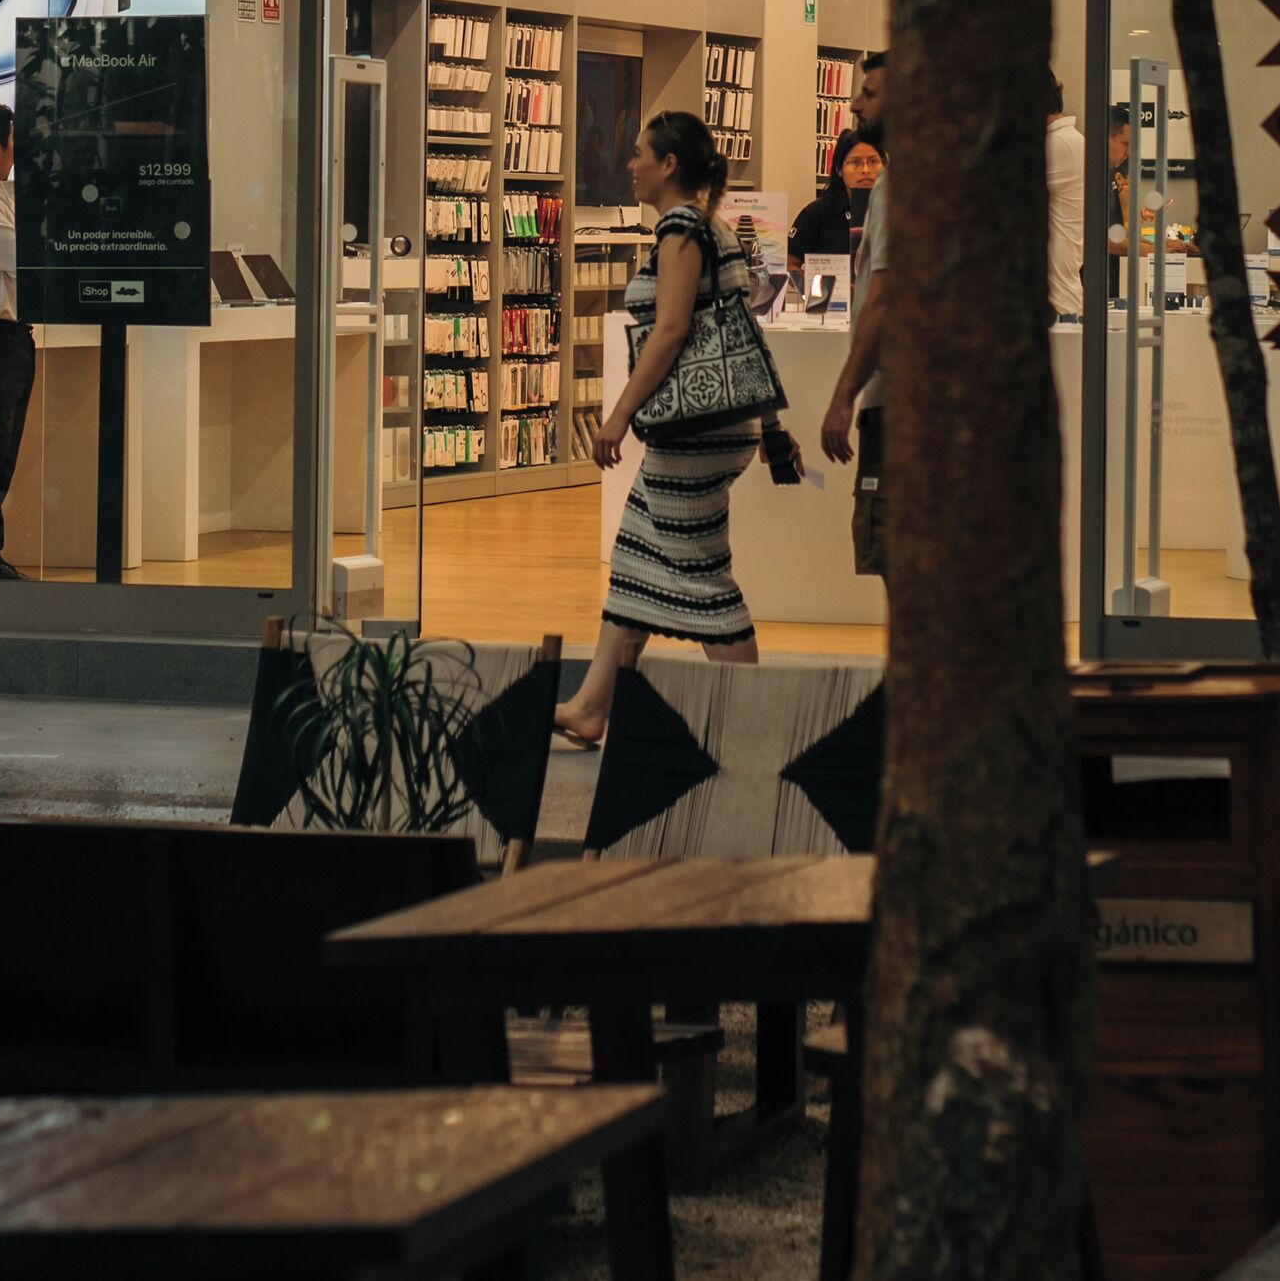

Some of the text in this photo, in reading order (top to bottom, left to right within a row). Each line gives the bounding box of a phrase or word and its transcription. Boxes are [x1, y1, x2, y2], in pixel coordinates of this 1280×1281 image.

[72, 54, 157, 68] MacBook Air
[67, 229, 155, 241] Un poder increíble.
[54, 242, 168, 253] Un precio extraordinario.
[83, 287, 109, 296] iShop
